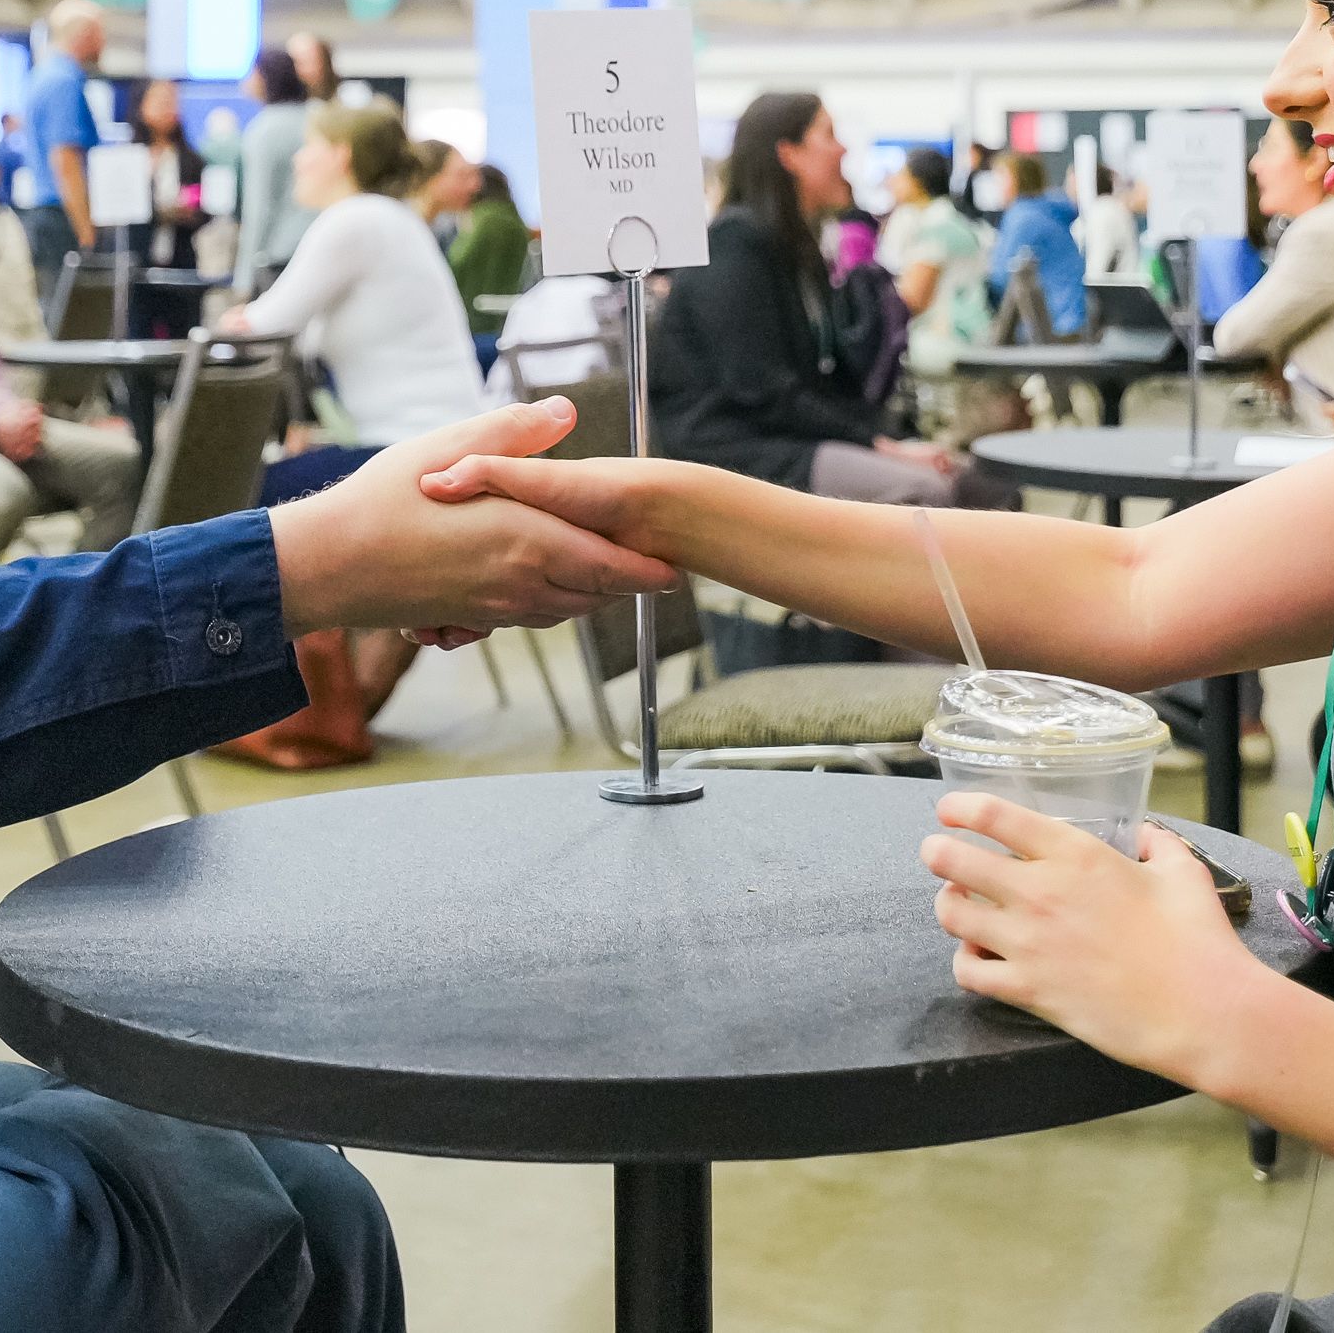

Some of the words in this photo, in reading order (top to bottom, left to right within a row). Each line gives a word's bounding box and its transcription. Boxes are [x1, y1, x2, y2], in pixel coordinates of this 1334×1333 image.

[605, 60, 620, 94] 5
[566, 110, 665, 135] Theodore
[581, 147, 656, 170] Wilson
[609, 180, 633, 194] MD
